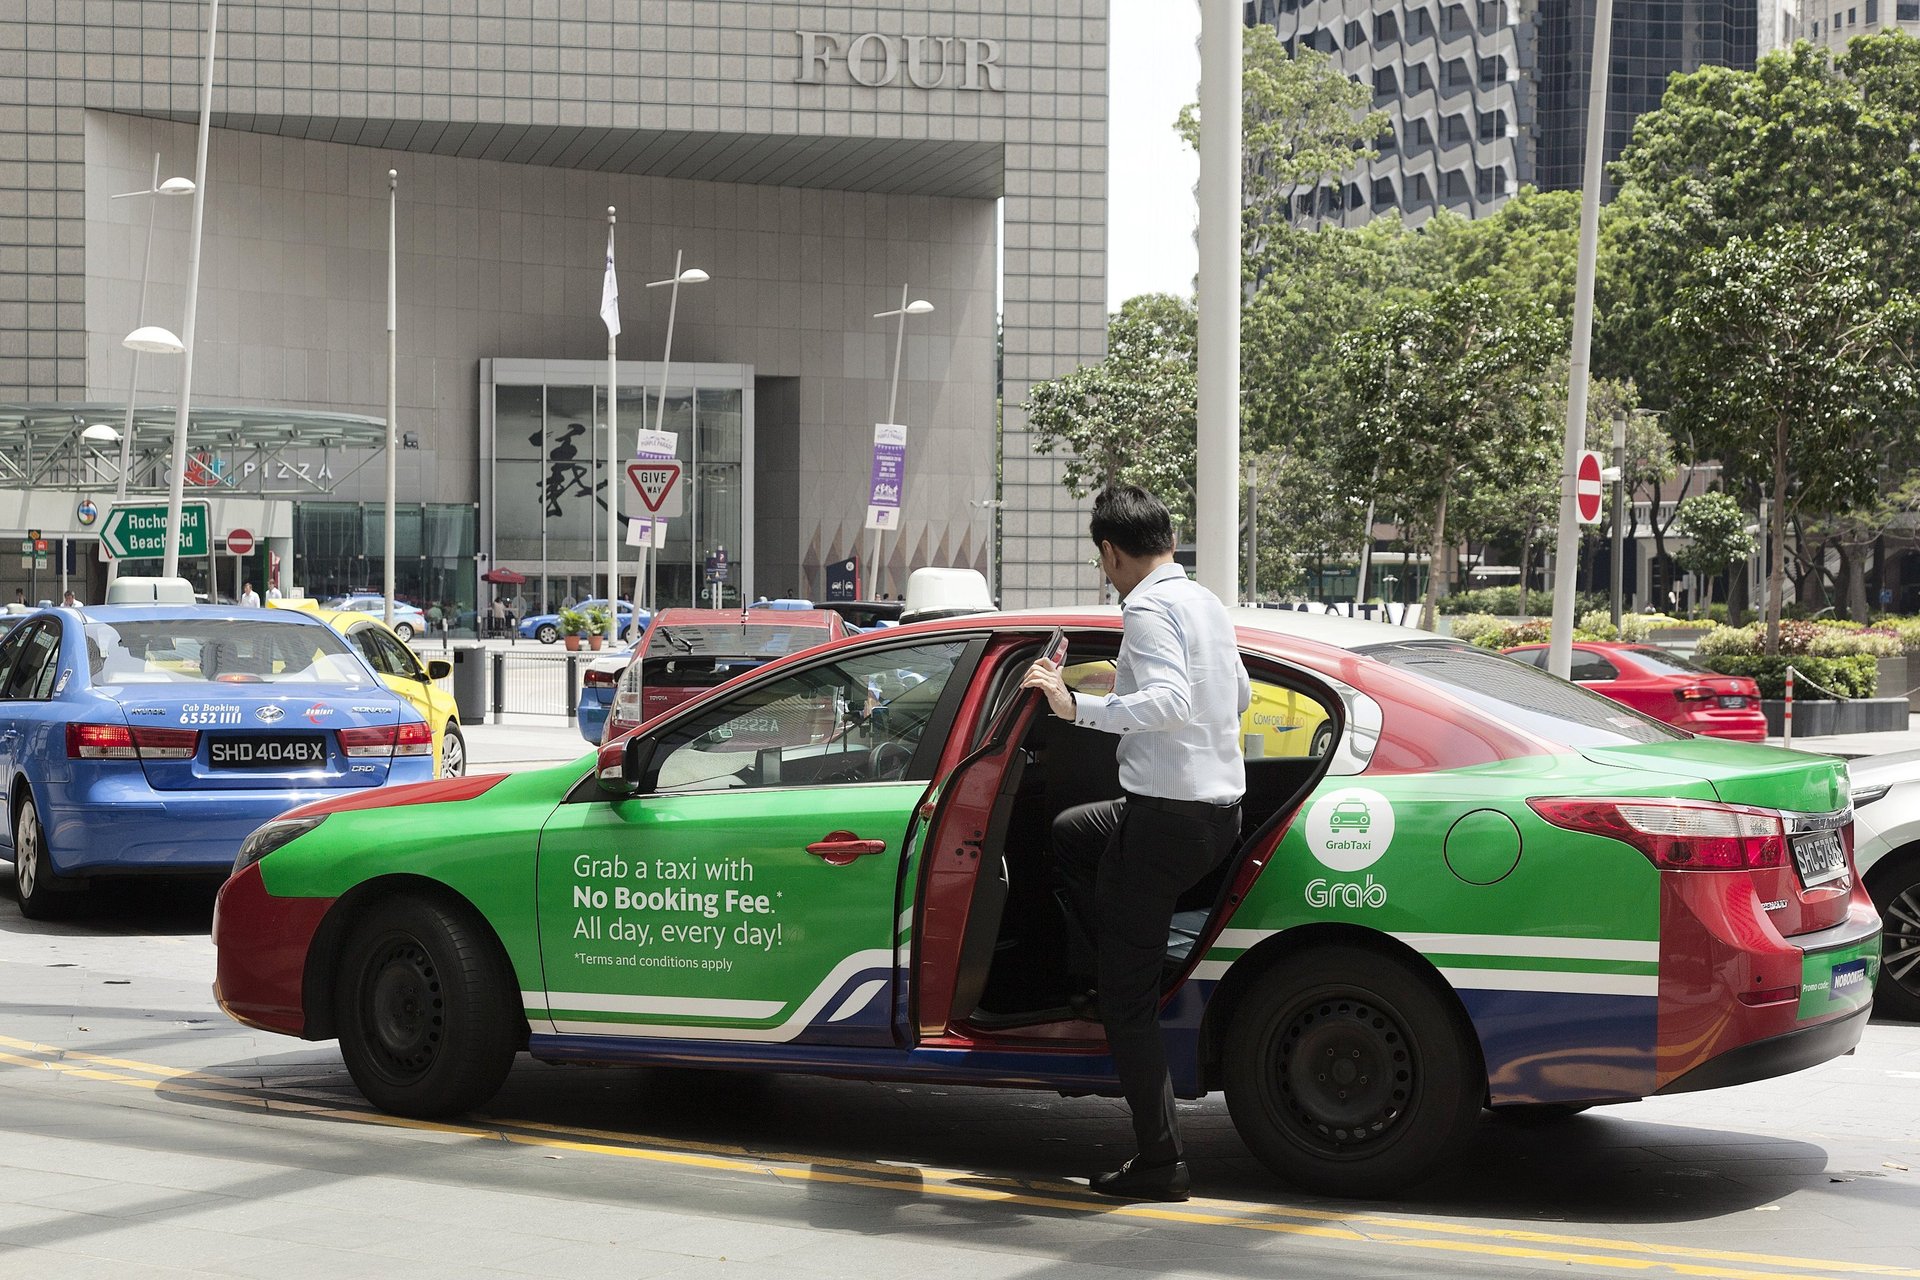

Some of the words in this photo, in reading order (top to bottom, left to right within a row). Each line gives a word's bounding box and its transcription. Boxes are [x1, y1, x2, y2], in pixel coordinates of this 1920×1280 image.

[794, 30, 1005, 92] FOUR
[243, 462, 333, 480] PIZZA
[641, 472, 667, 484] GIVE
[647, 486, 662, 494] WAY
[128, 514, 168, 529] Rocho
[181, 512, 198, 527] Rd
[182, 703, 200, 712] Cab
[203, 703, 240, 713] Booking
[1325, 840, 1371, 850] GrabTaxi
[573, 854, 628, 878] Grab
[635, 861, 647, 879] a
[656, 857, 697, 880] taxi
[705, 857, 753, 881] with
[1305, 874, 1387, 909] Grab
[573, 885, 608, 909] No
[615, 887, 719, 918] Booking
[573, 916, 601, 939] All
[608, 916, 654, 947] day,
[661, 923, 726, 950] every
[733, 921, 783, 951] day!
[616, 954, 636, 967] and
[639, 955, 699, 969] conditions
[701, 957, 733, 973] apply
[1802, 983, 1817, 993] Promo
